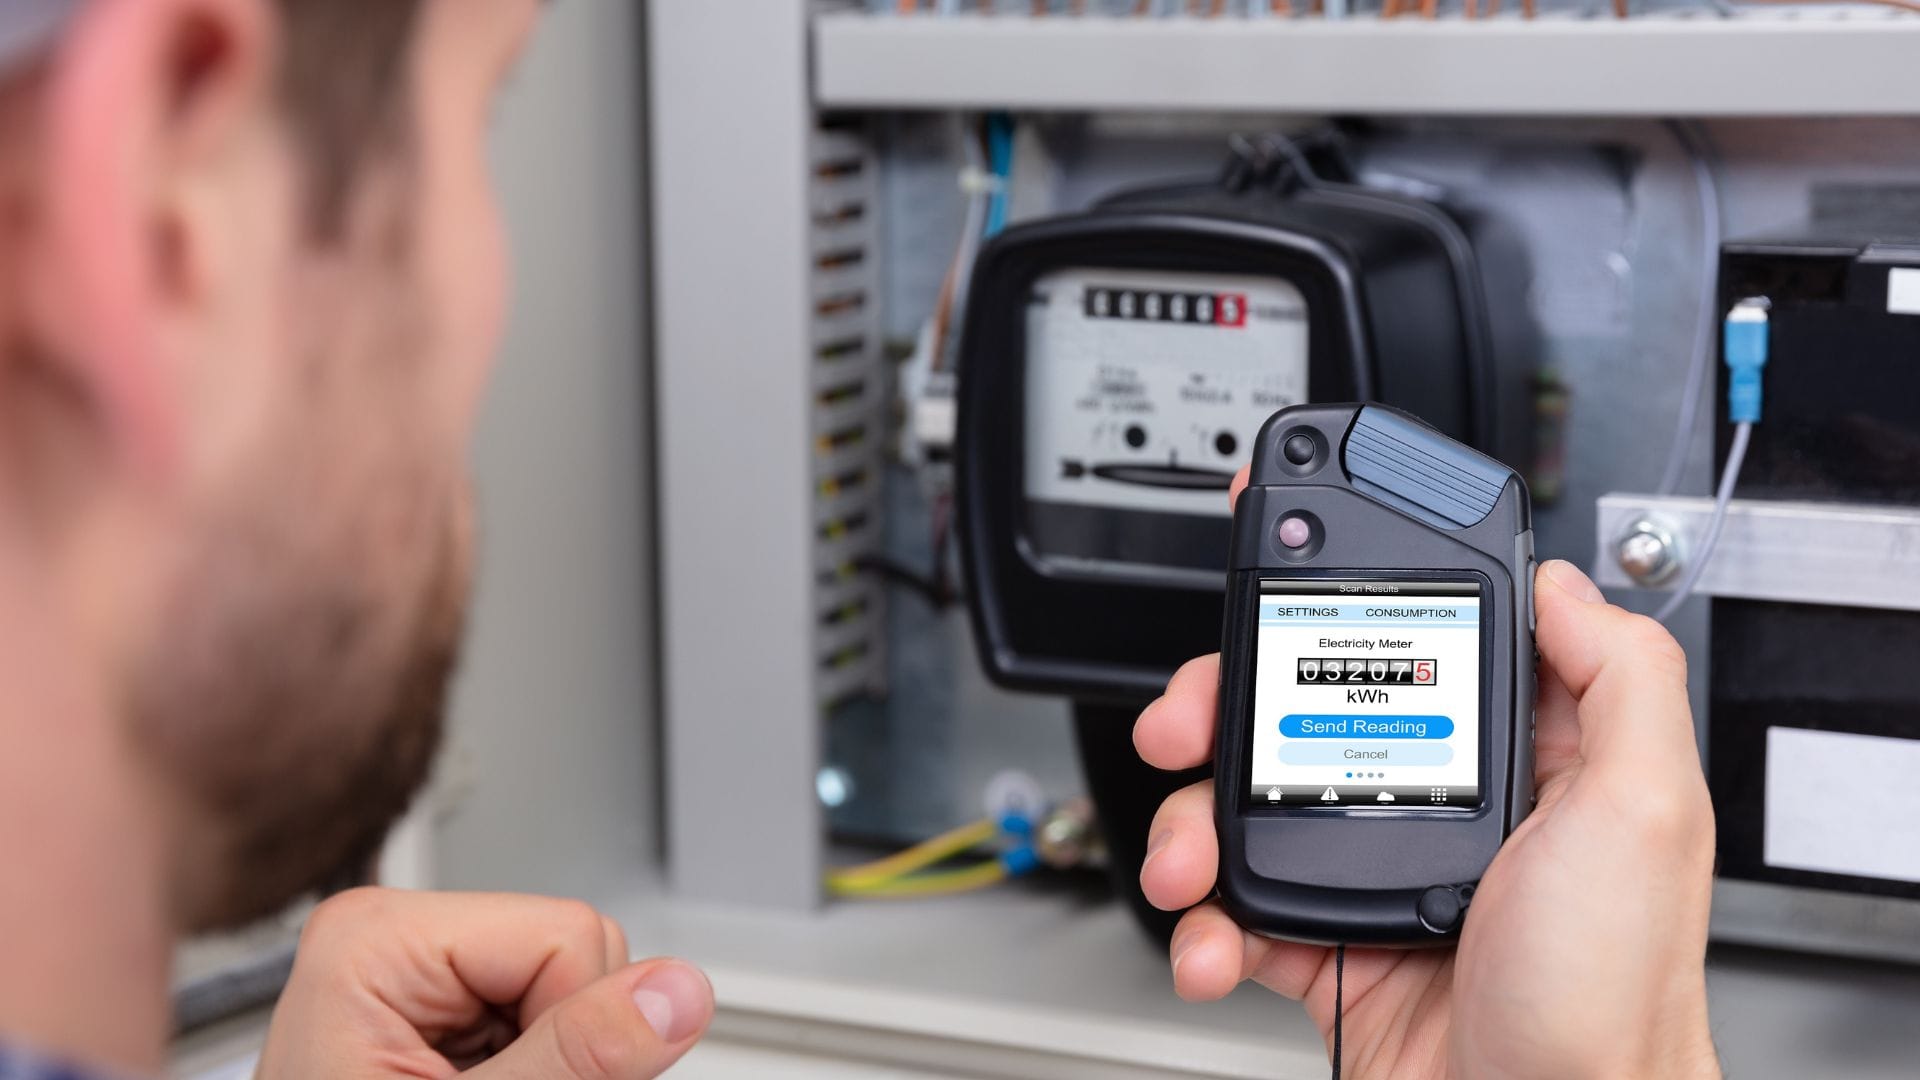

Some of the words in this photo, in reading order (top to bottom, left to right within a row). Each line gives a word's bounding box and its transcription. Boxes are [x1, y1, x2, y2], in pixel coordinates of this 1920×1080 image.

[1339, 584, 1363, 593] Scan
[1365, 584, 1399, 593] Results
[1277, 607, 1339, 617] SETTINGS
[1365, 608, 1457, 618] CONSUMPTION
[1319, 638, 1375, 650] Electricity
[1378, 639, 1413, 649] Meter
[1302, 661, 1432, 682] 032075
[1346, 689, 1389, 704] kWh
[1301, 720, 1347, 734] Send
[1353, 720, 1427, 737] Reading
[1344, 749, 1388, 760] Cancel
